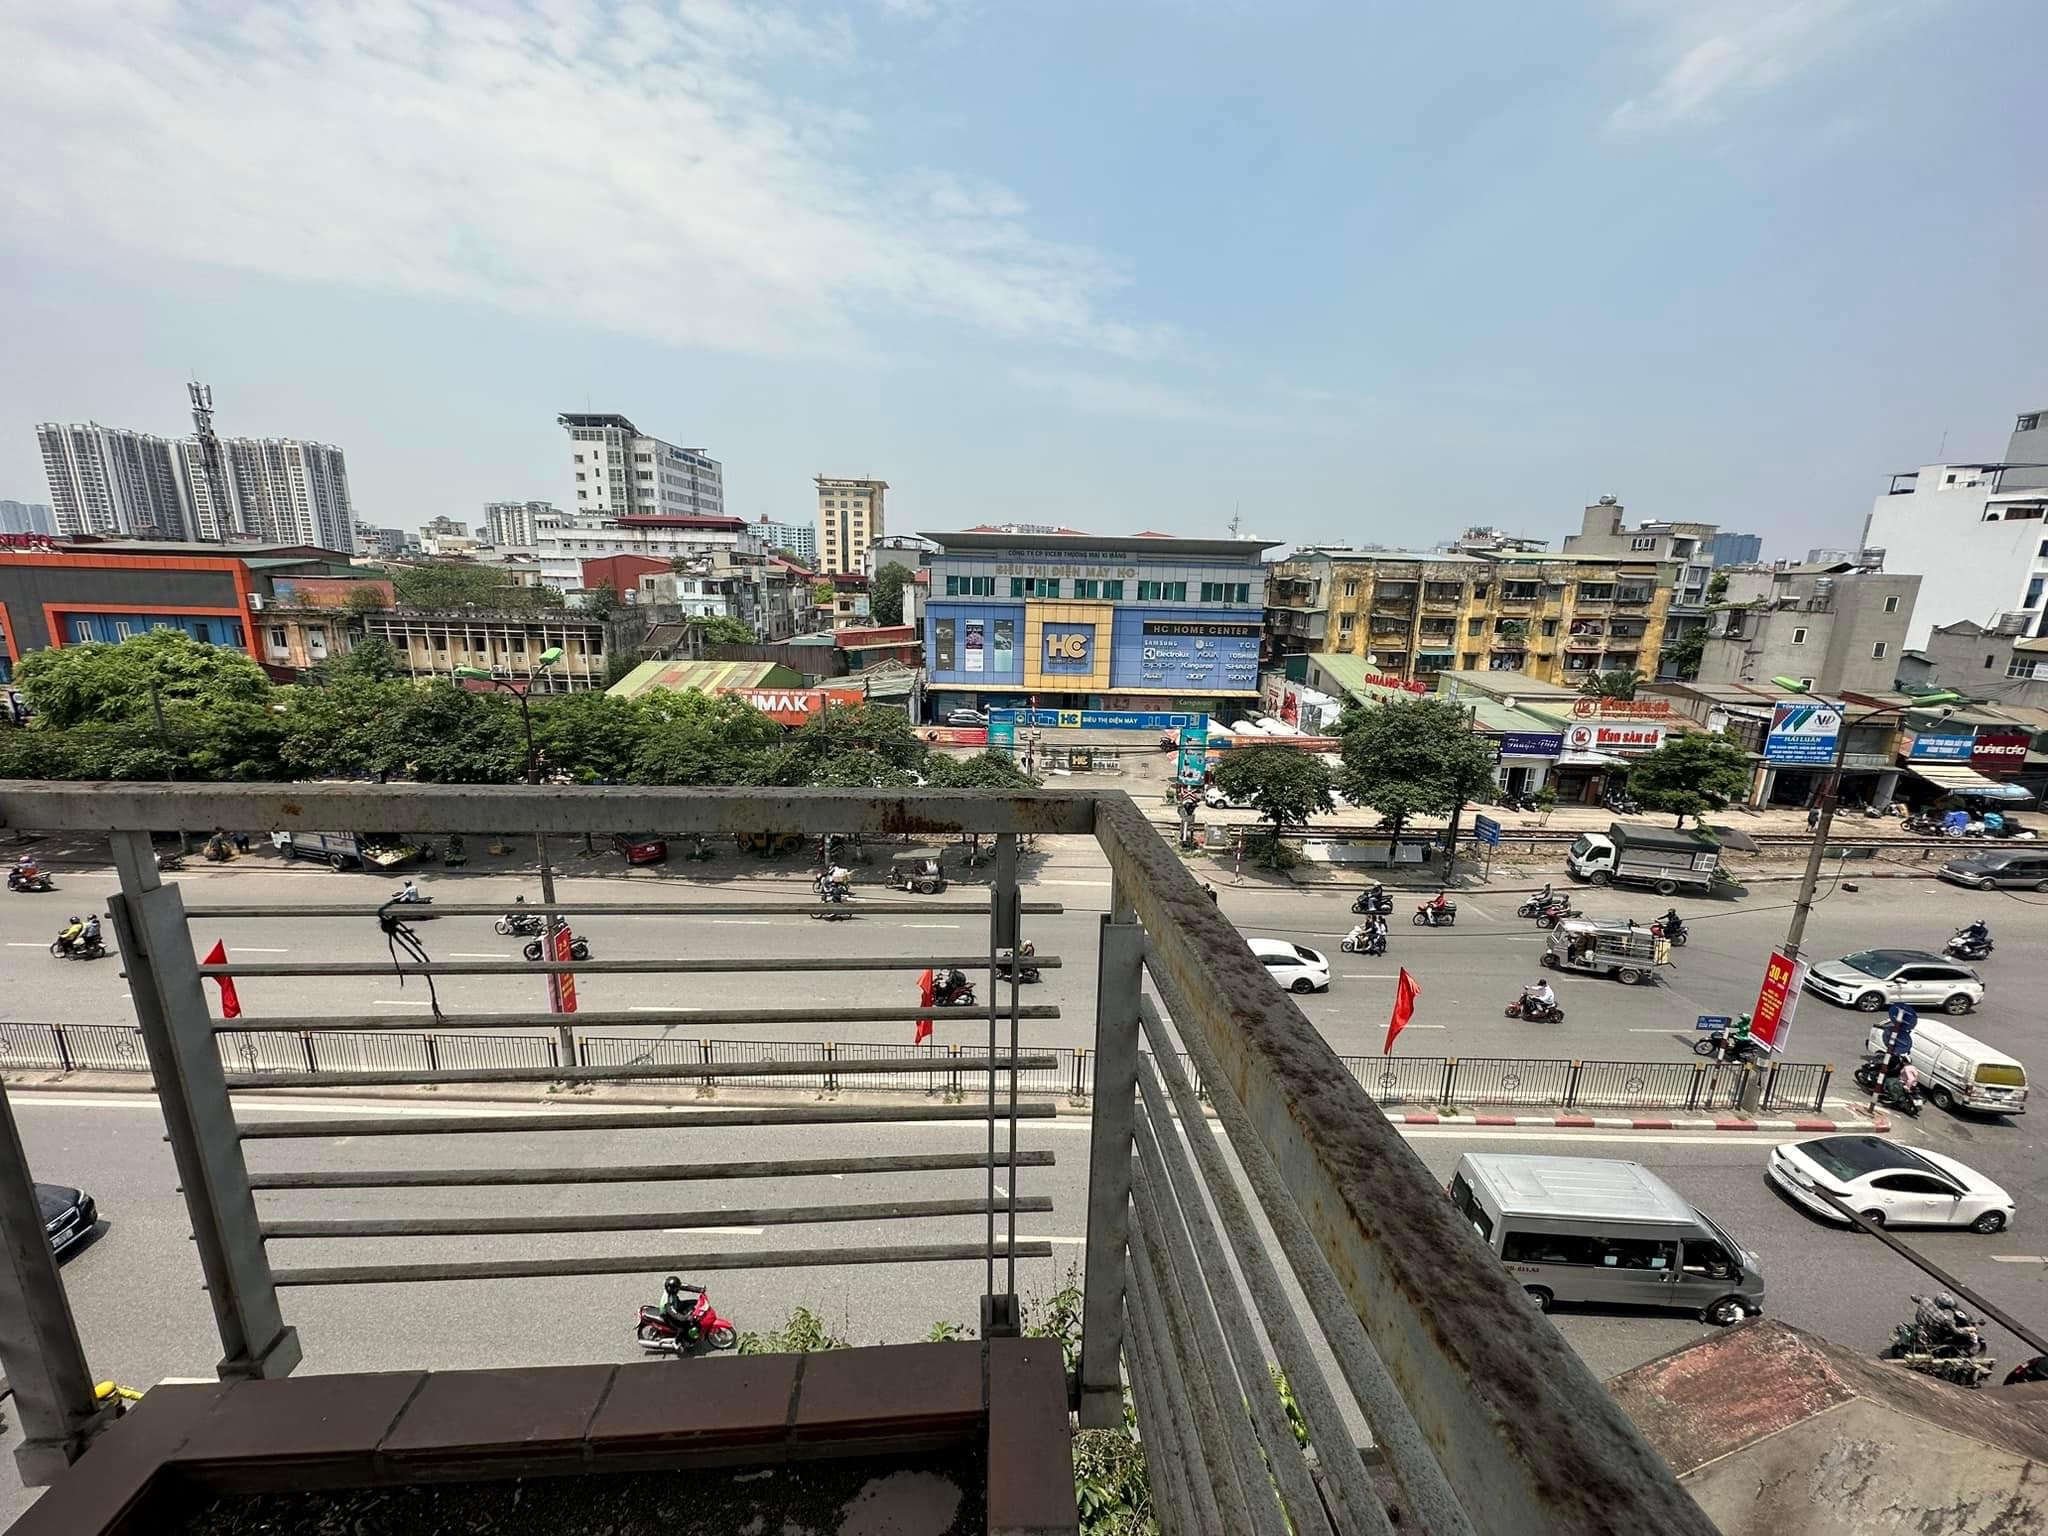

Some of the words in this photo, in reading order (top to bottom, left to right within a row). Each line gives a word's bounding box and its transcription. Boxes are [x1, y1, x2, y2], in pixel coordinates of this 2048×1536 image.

[1154, 625, 1168, 633] HC
[1174, 626, 1204, 634] HOME
[1208, 626, 1248, 635] CENTER
[1046, 633, 1088, 658] HC
[1156, 650, 1190, 658] Electrolux
[1060, 714, 1079, 724] HC
[1973, 744, 2005, 754] QUẢNG
[2006, 744, 2026, 755] CÁO
[1072, 754, 1088, 765] HC
